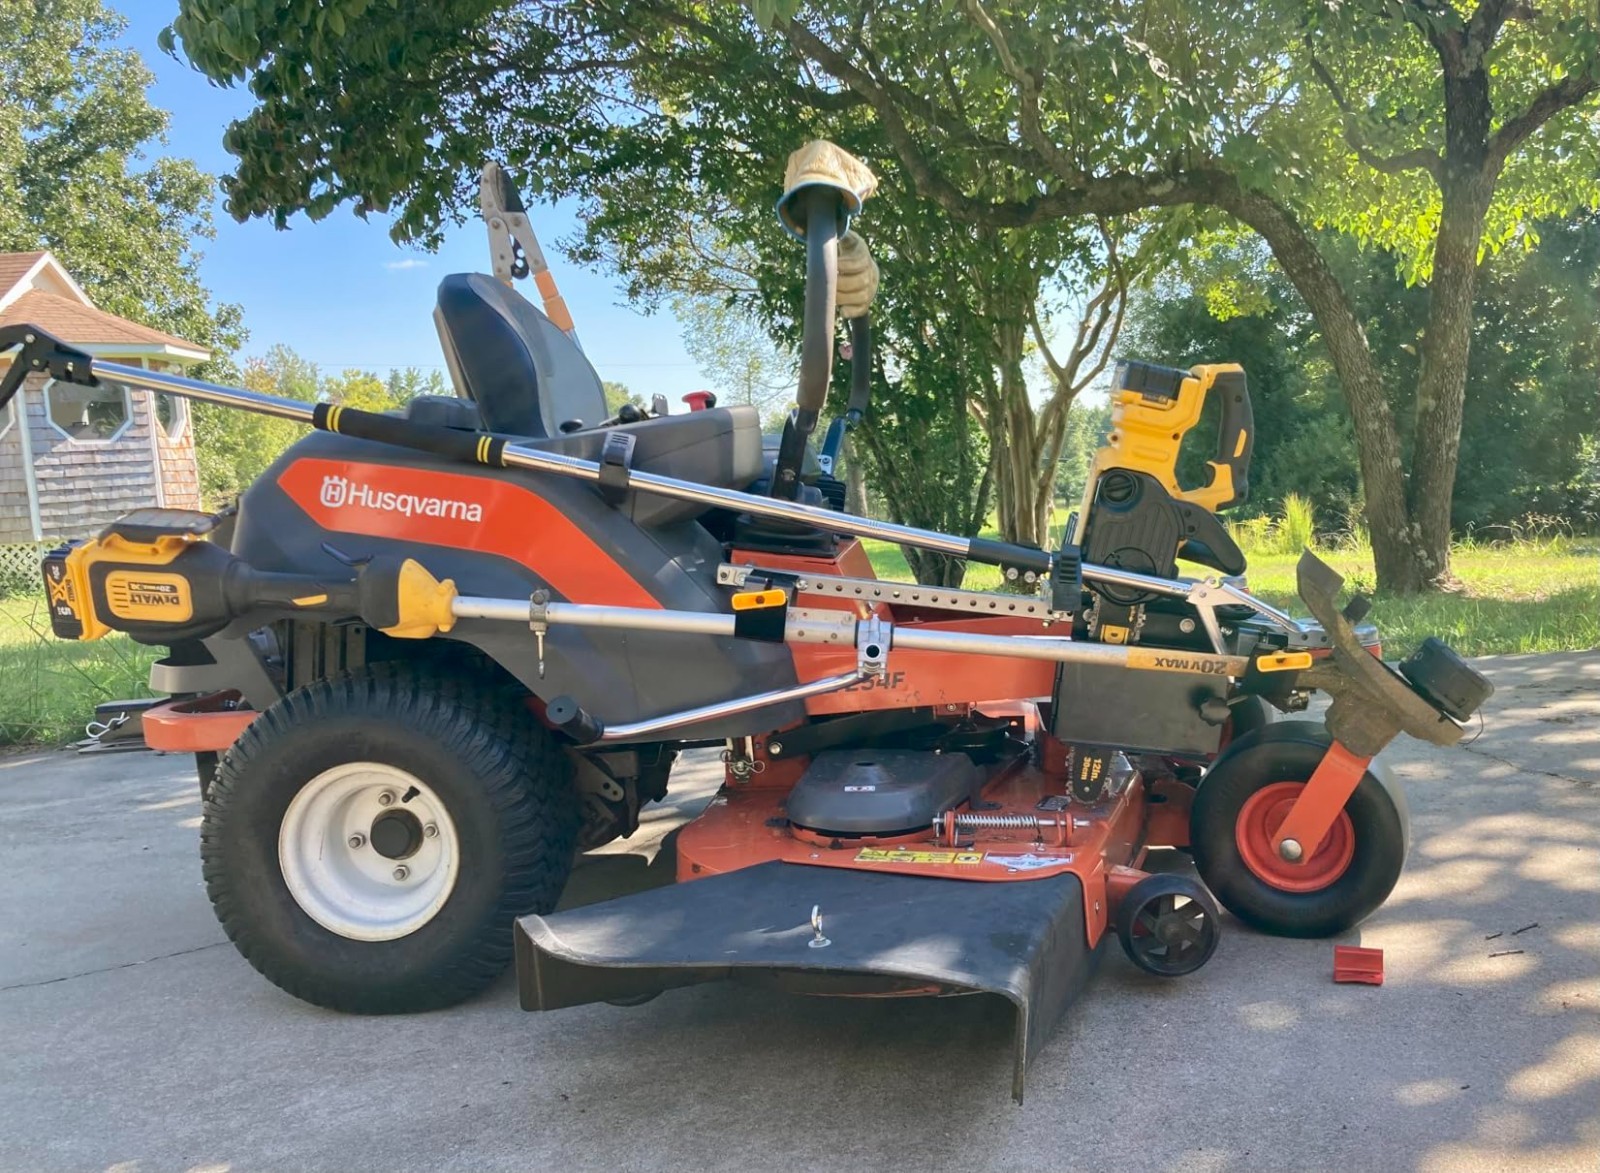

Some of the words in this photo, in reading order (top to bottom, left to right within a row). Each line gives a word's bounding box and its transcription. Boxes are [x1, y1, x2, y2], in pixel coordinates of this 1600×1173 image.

[348, 483, 482, 522] Husqvarna
[1154, 657, 1189, 670] MAX
[1080, 756, 1091, 780] 30cm
